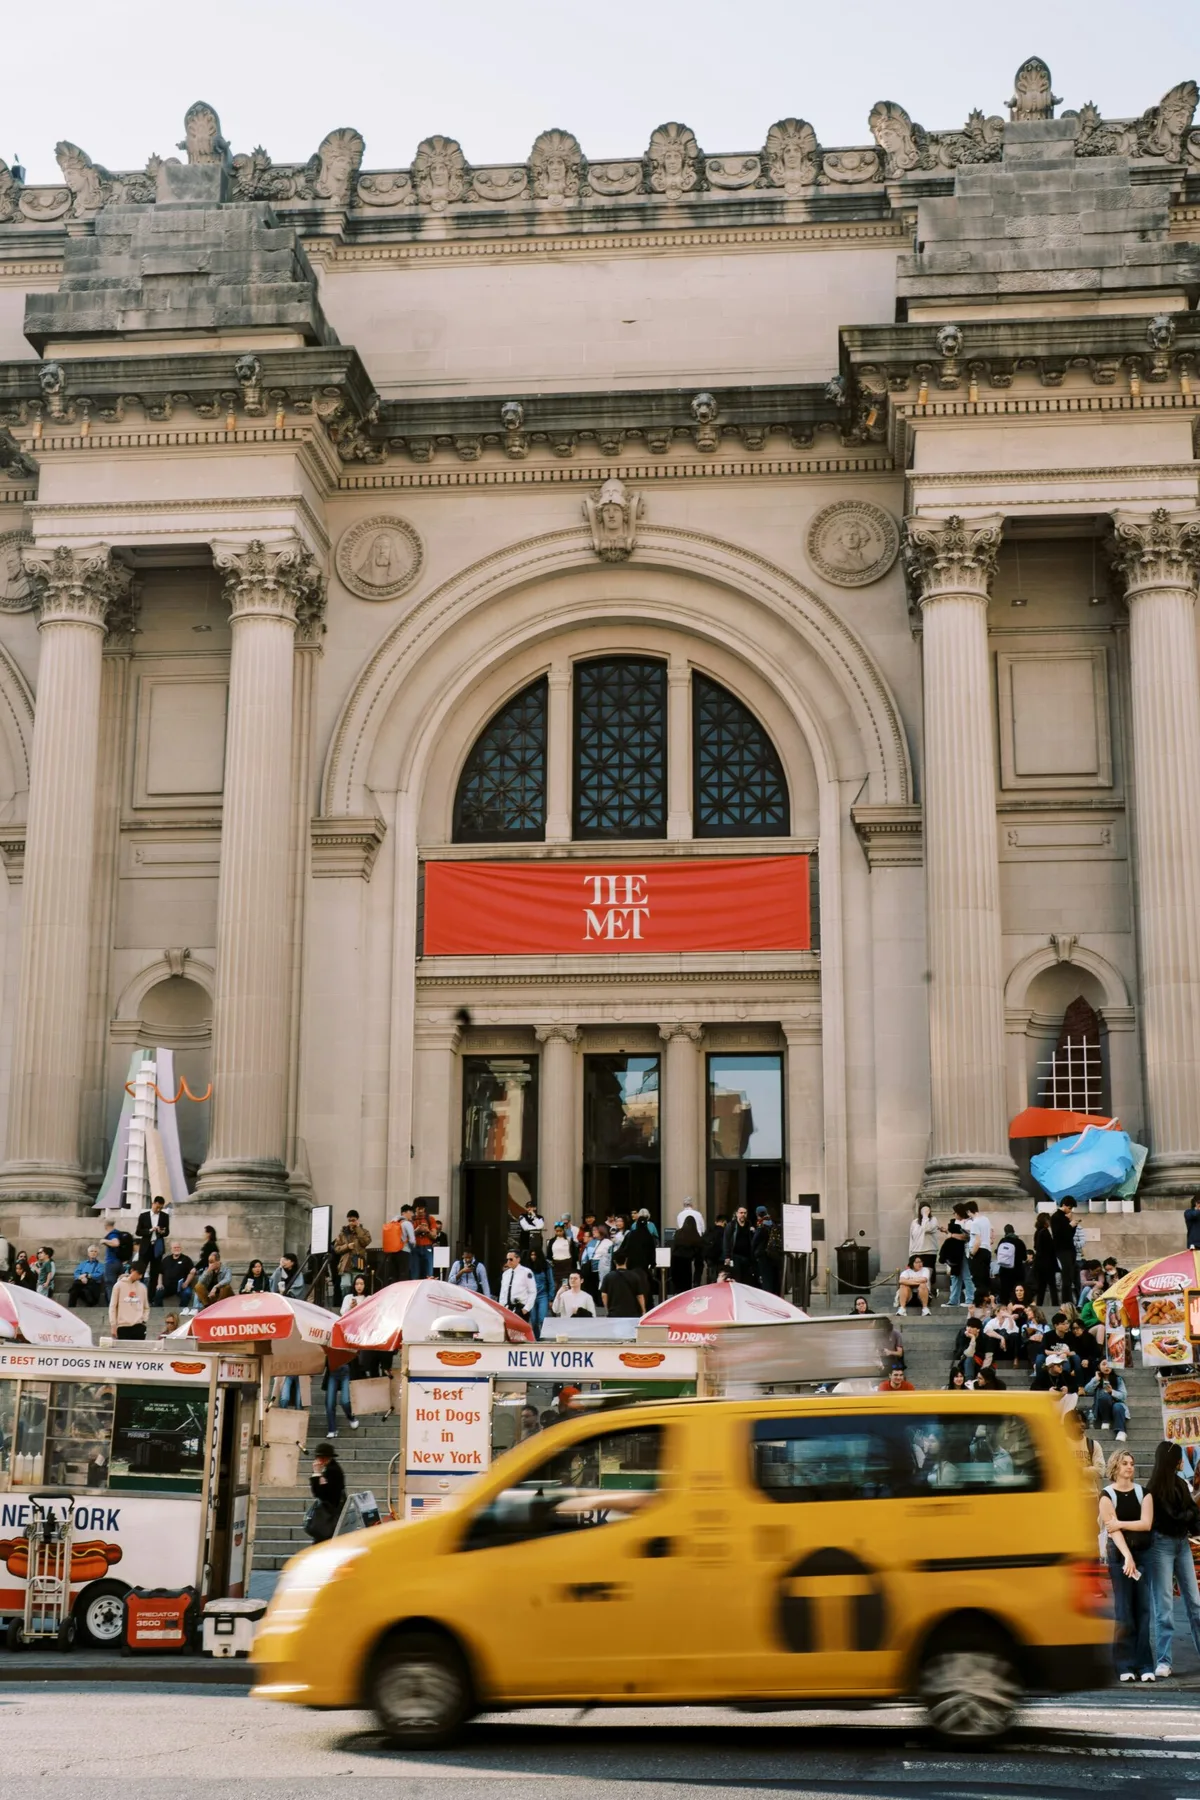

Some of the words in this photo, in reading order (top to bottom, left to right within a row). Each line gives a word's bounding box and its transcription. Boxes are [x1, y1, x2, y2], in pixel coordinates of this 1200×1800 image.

[584, 875, 649, 905] THE
[582, 908, 650, 940] MET
[210, 1324, 236, 1337] COLD
[238, 1323, 277, 1336] DRINKS
[309, 1327, 324, 1339] HOT
[38, 1333, 51, 1342] HOT
[53, 1334, 74, 1344] DOGS
[10, 1356, 35, 1365] BEST
[38, 1357, 59, 1366] HOT
[62, 1358, 90, 1368] DOGS
[94, 1359, 105, 1368] IN
[109, 1360, 133, 1370] NEW
[135, 1361, 164, 1371] YORK
[508, 1351, 544, 1367] NEW
[551, 1351, 594, 1368] YORK
[433, 1388, 463, 1400] Best
[416, 1408, 440, 1421] Hot
[445, 1408, 480, 1425] Dogs
[441, 1428, 454, 1442] in
[413, 1451, 444, 1463] New
[450, 1450, 482, 1464] York
